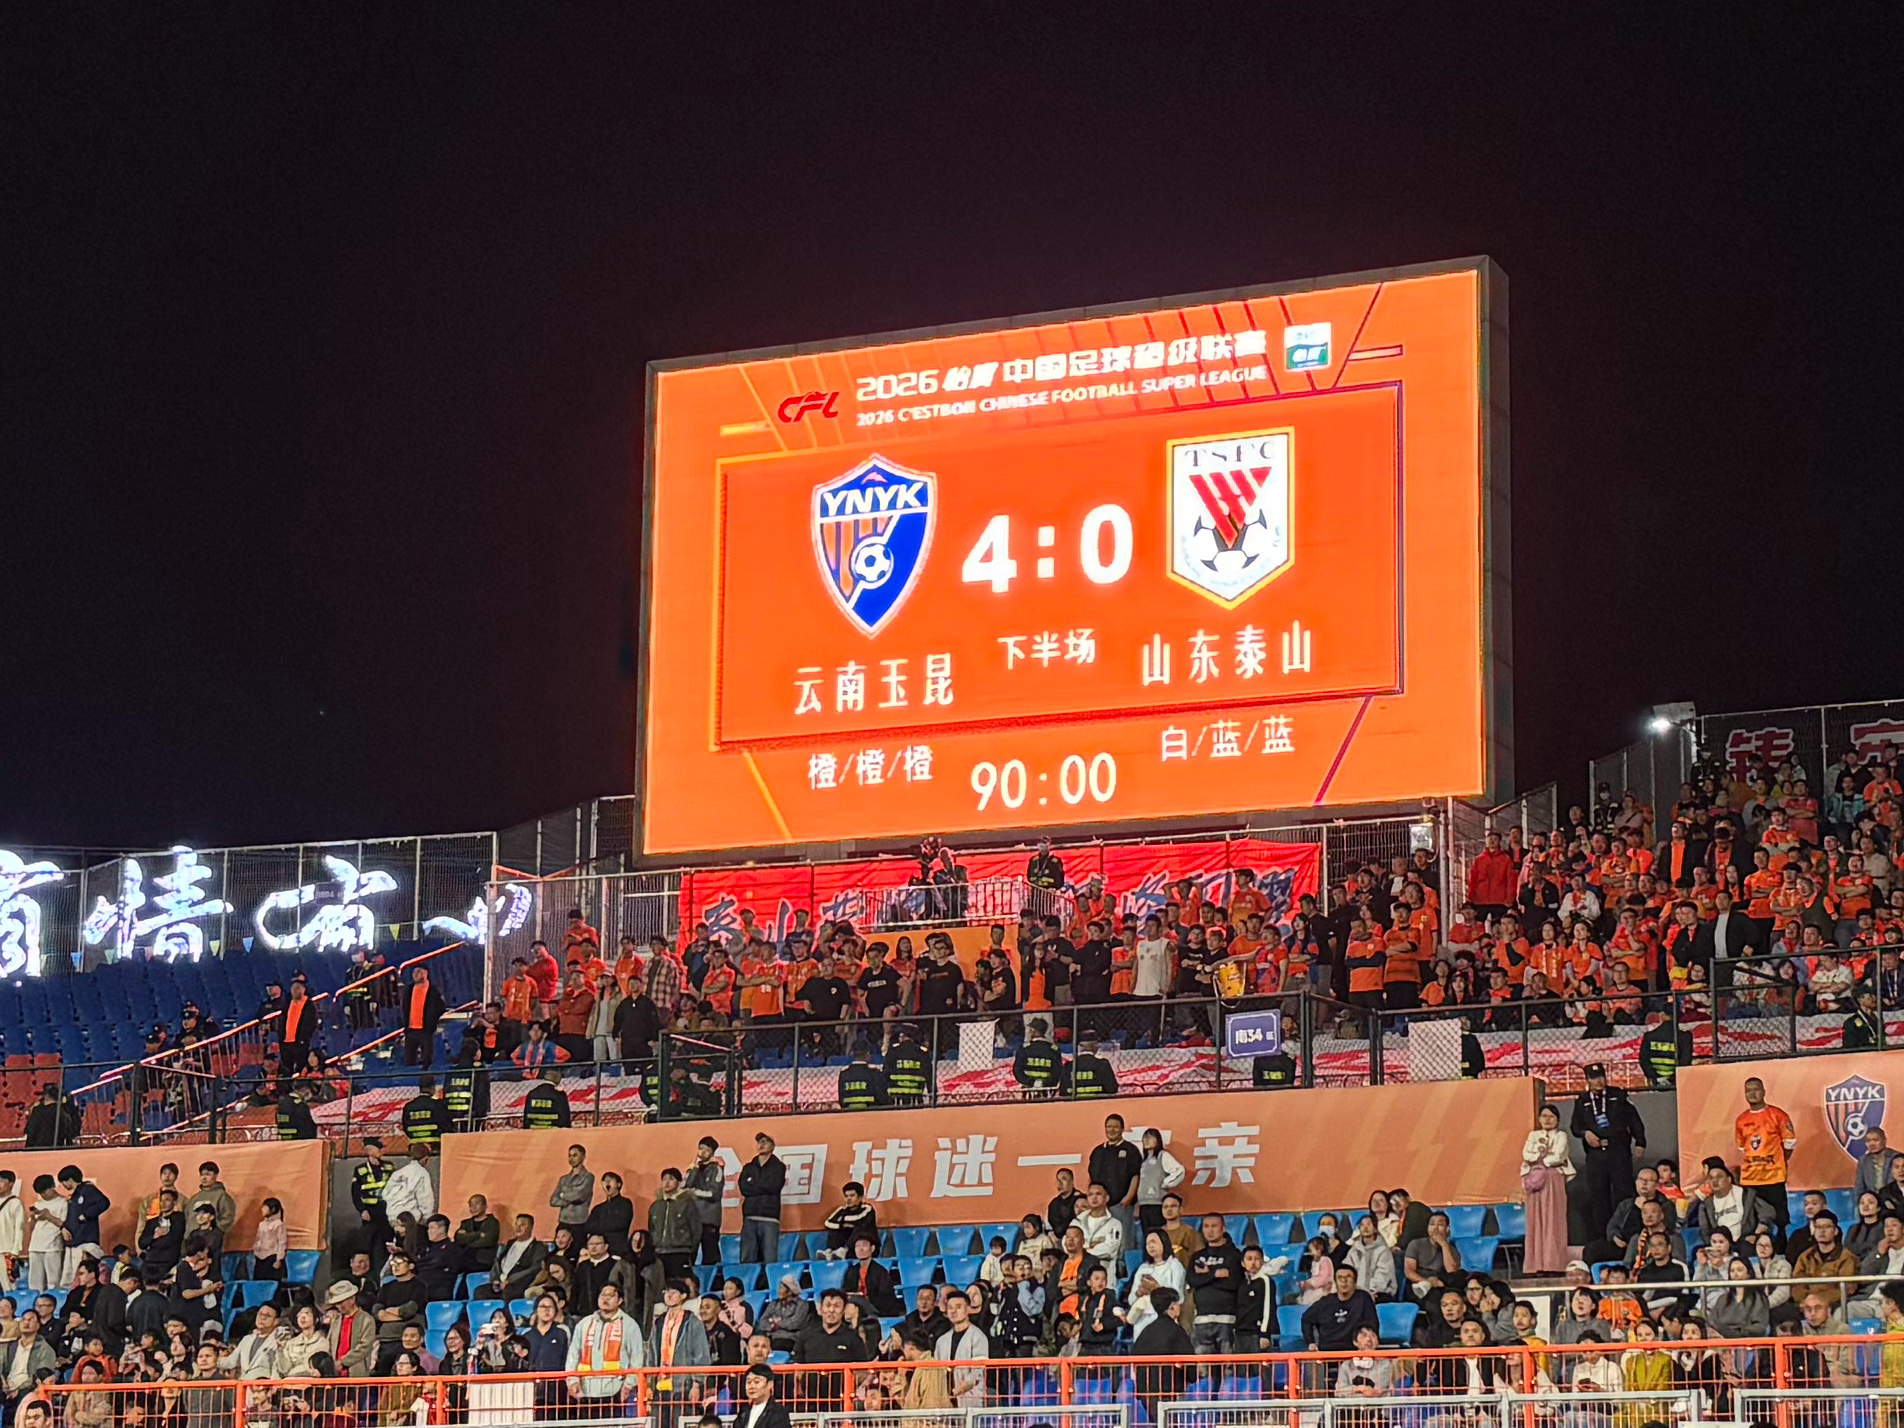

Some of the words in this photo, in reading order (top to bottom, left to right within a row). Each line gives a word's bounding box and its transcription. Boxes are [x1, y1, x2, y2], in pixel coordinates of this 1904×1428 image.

[856, 370, 939, 402] 2026
[1003, 329, 1268, 385] 中国足球超级联赛
[856, 408, 895, 427] 2026
[978, 391, 1049, 413] CHINESE
[1050, 379, 1138, 406] FOOTBALL
[1140, 373, 1198, 395] SUPER
[1199, 363, 1268, 389] LEAGUE
[1184, 440, 1275, 468] TSFC
[822, 481, 925, 517] YNYK
[962, 503, 1134, 595] 4:0
[996, 628, 1098, 670] 下半场
[1141, 620, 1313, 688] 山东泰山
[793, 652, 956, 717] 云南玉昆
[1162, 717, 1297, 763] 白/蓝/蓝
[807, 745, 935, 792] 橙/橙/橙
[971, 753, 1118, 813] 90:00
[1827, 1085, 1882, 1100] YNYK
